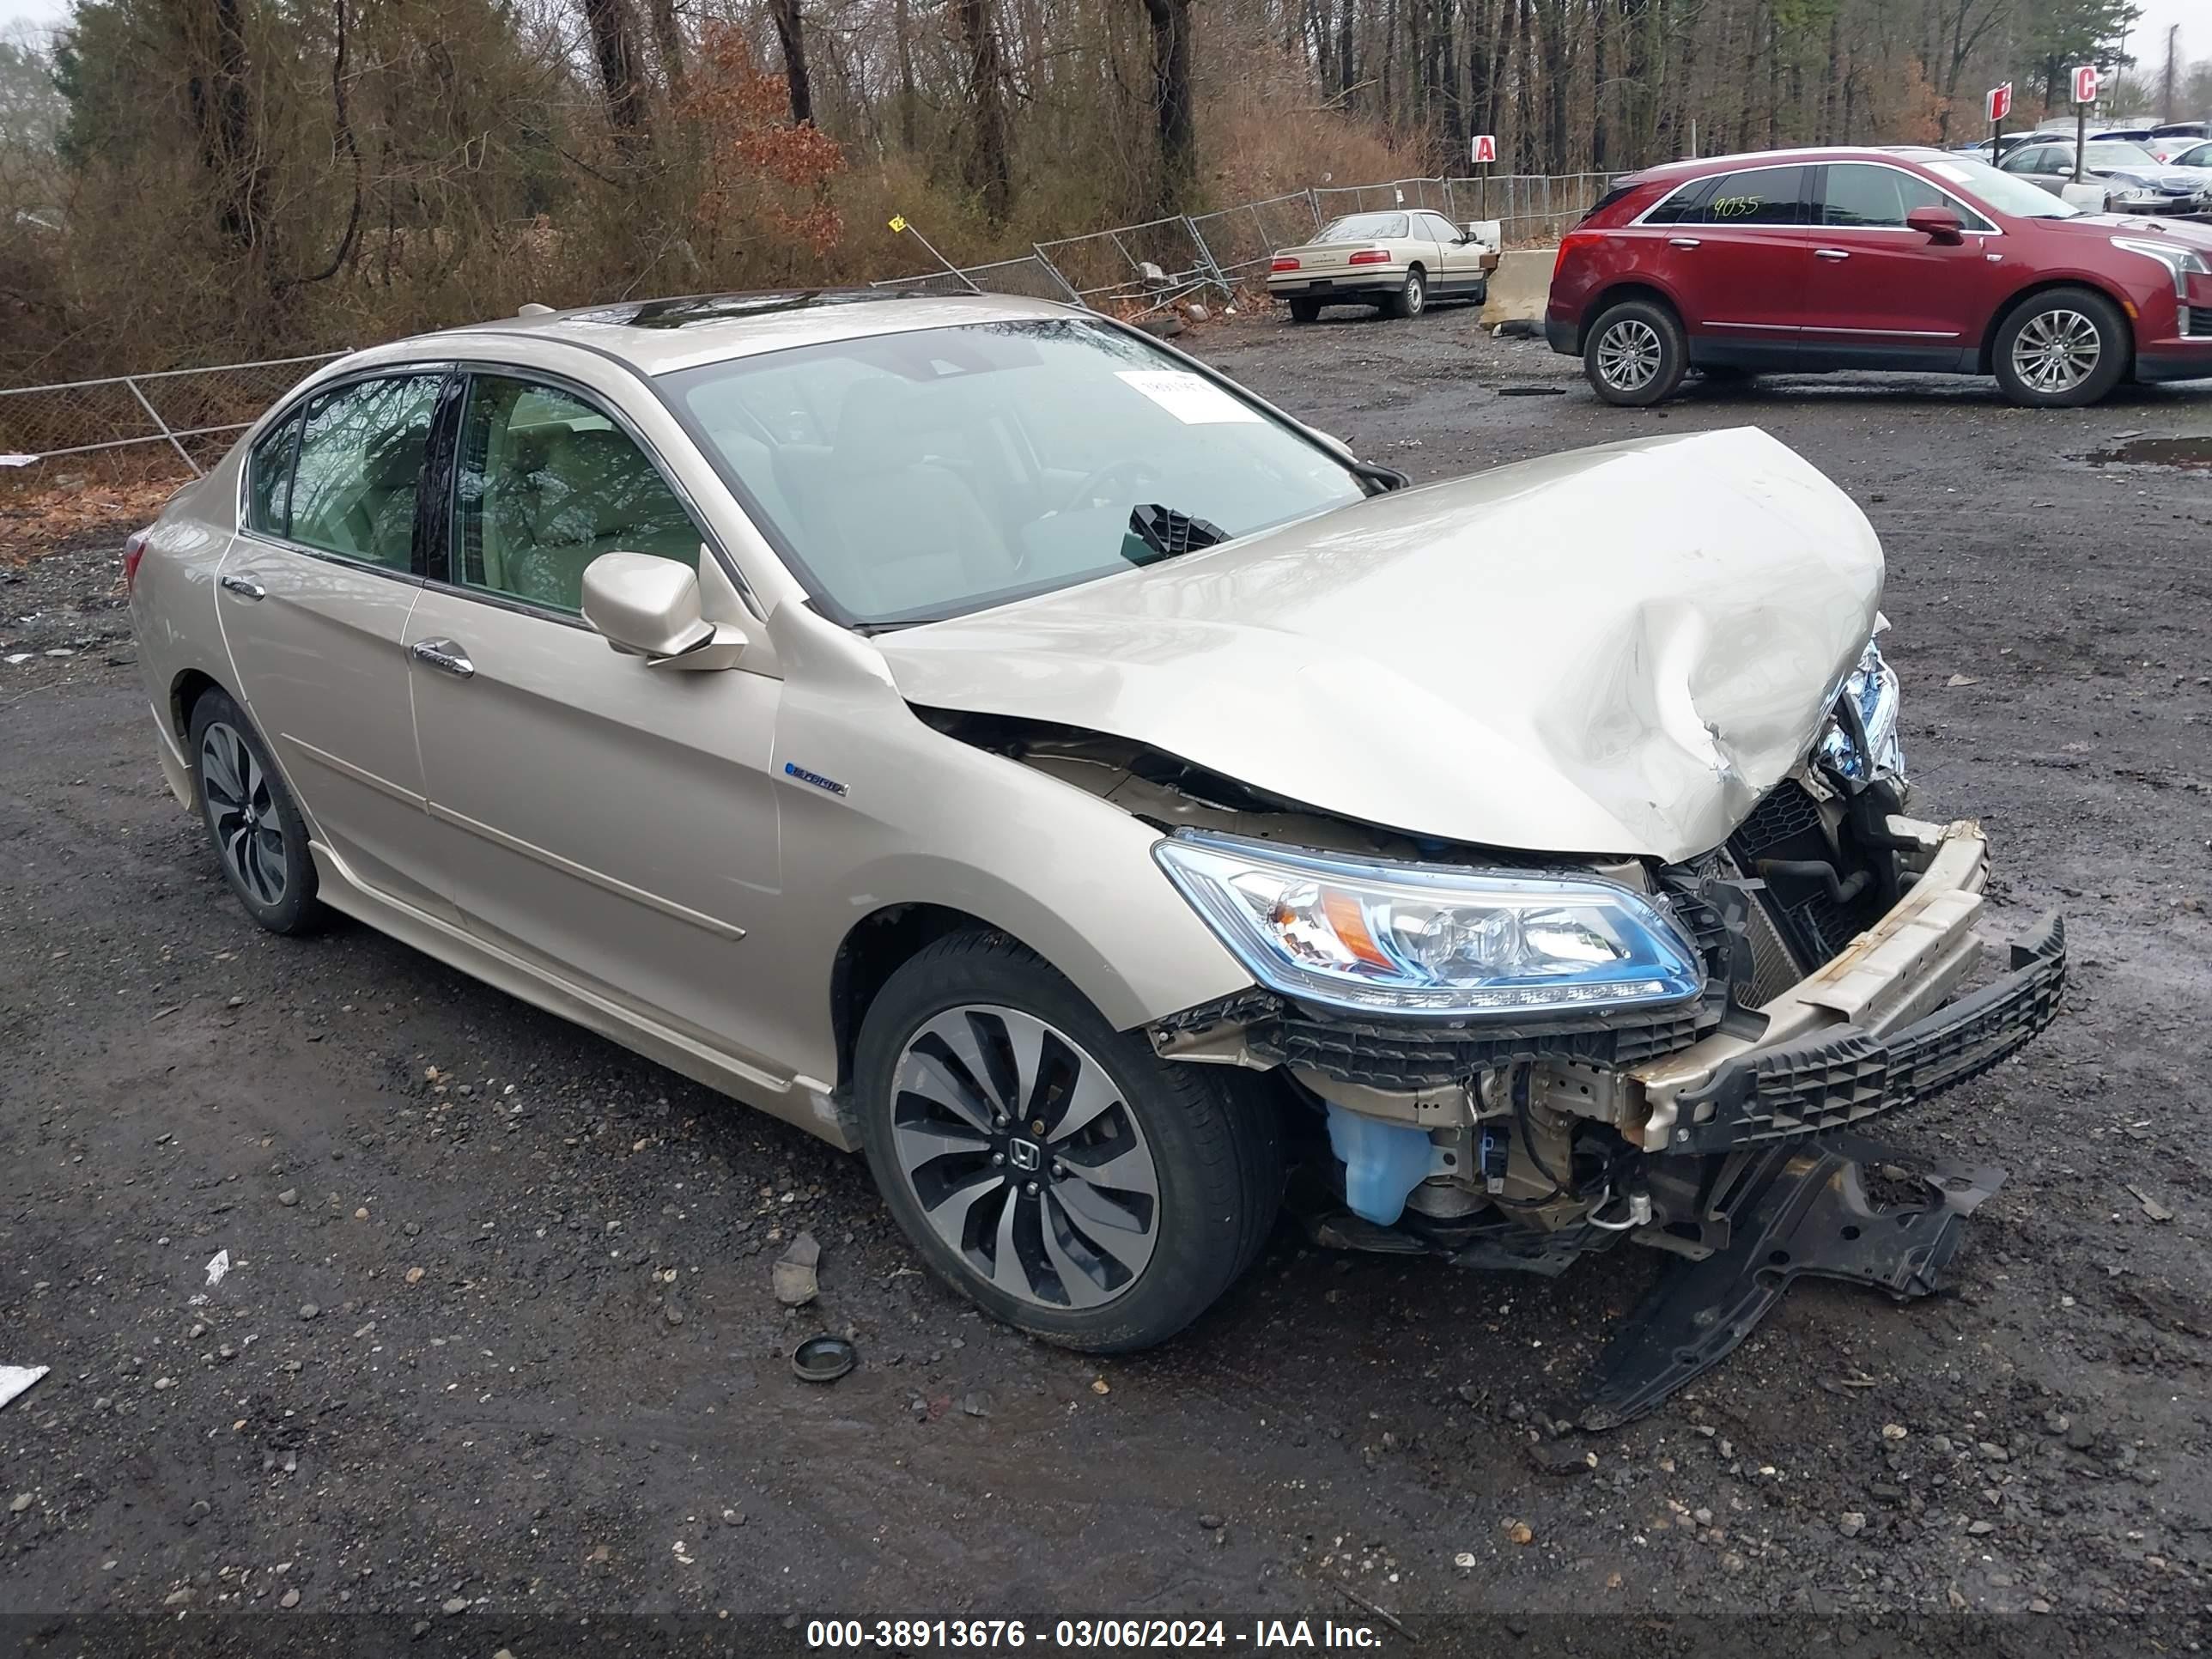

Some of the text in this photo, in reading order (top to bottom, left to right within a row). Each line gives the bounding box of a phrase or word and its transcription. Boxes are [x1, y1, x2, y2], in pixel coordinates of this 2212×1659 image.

[2078, 68, 2095, 100] C
[1991, 85, 2010, 119] B
[1477, 137, 1495, 161] A
[1714, 195, 1765, 220] 9035
